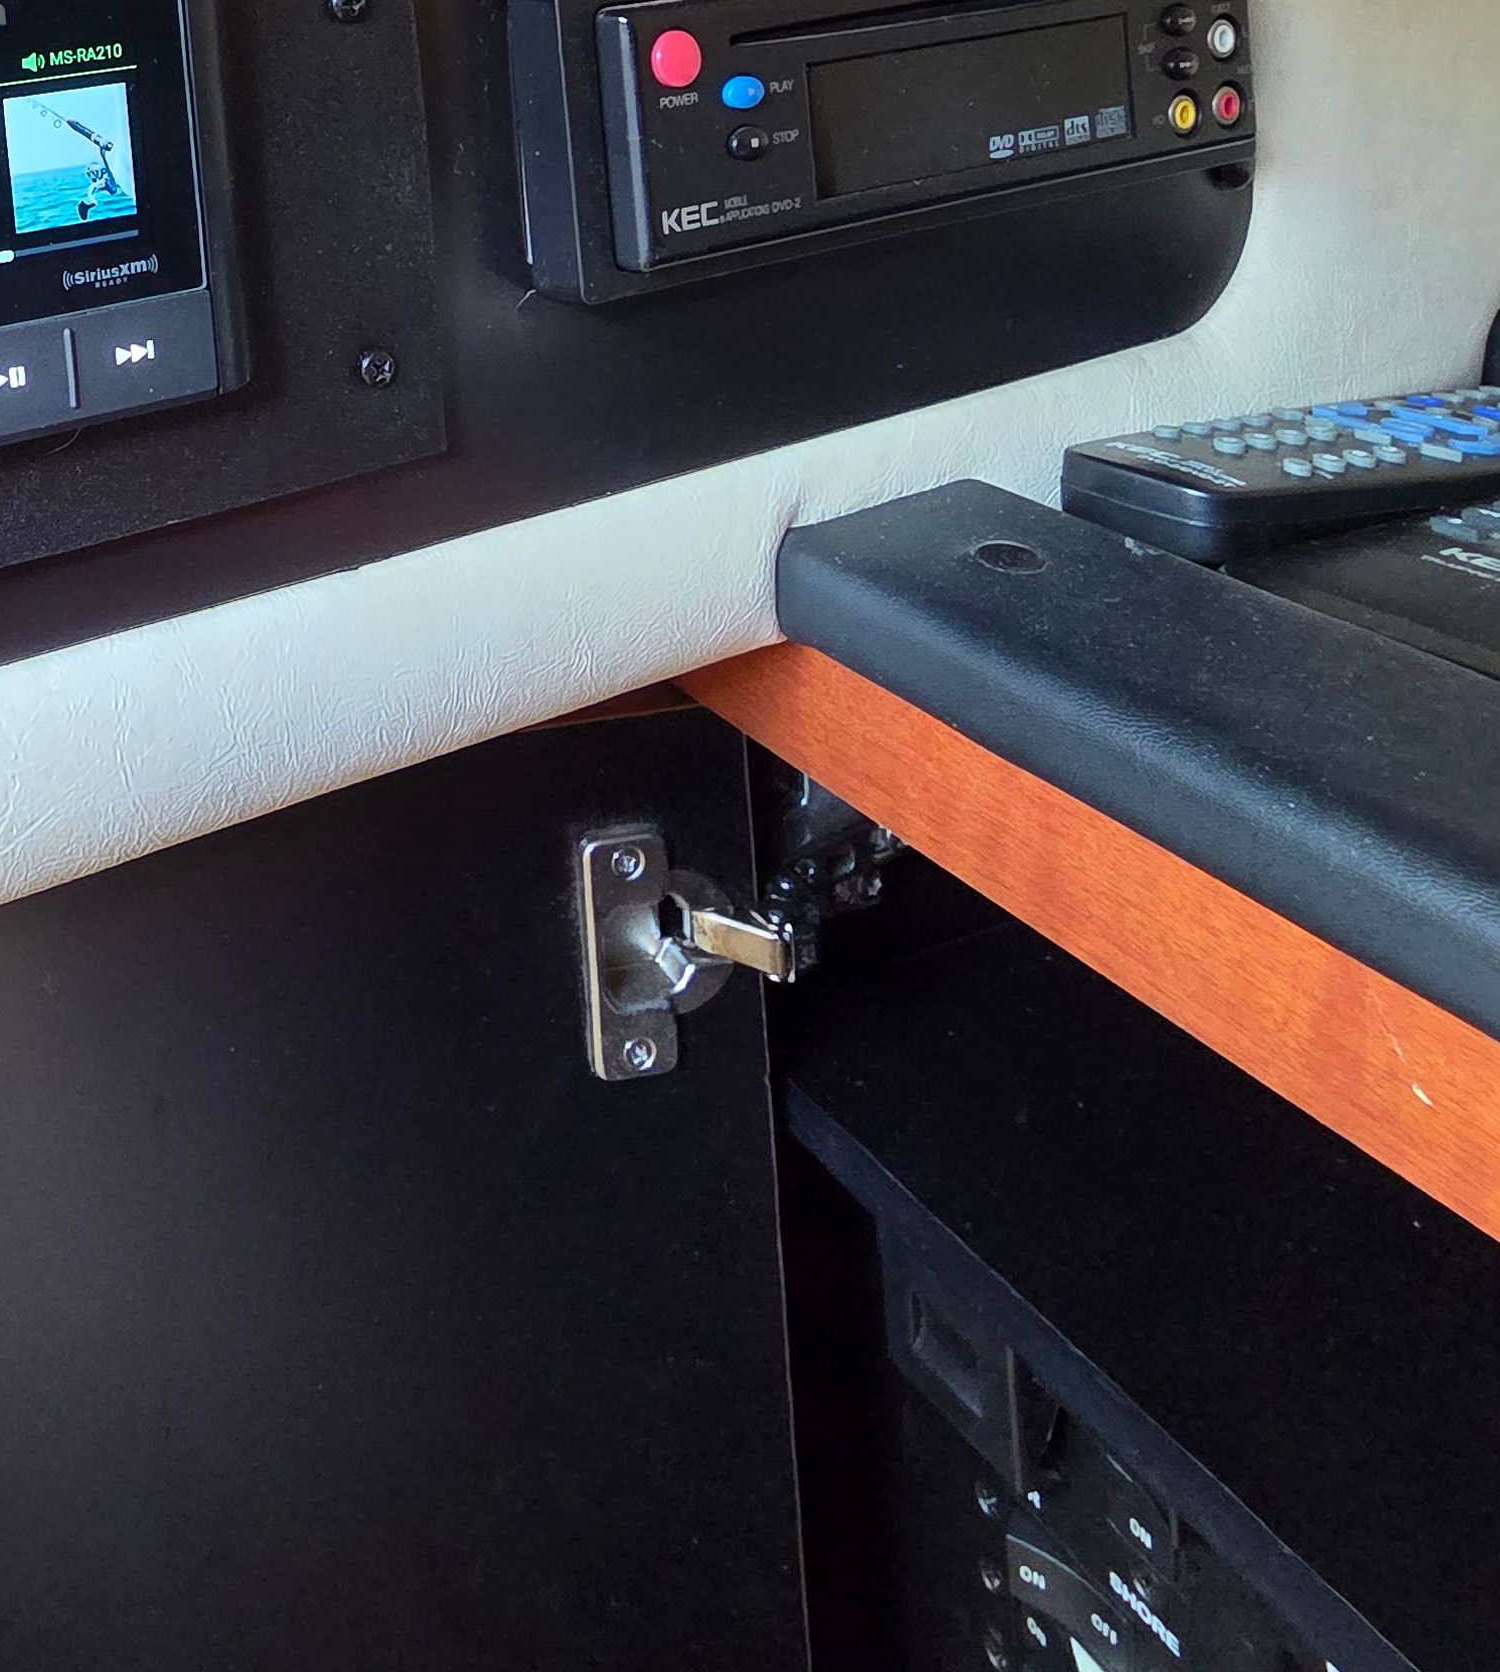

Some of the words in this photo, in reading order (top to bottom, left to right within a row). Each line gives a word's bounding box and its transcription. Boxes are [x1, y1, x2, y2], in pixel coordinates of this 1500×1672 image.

[49, 42, 123, 68] MS-RA210
[769, 80, 795, 94] PLAY
[659, 92, 699, 109] POWER
[772, 128, 799, 144] STOP
[661, 200, 720, 236] KEC
[94, 276, 128, 288] READY
[1129, 1517, 1152, 1549] ON
[1019, 1565, 1046, 1590] ON
[1109, 1571, 1181, 1658] SHORE
